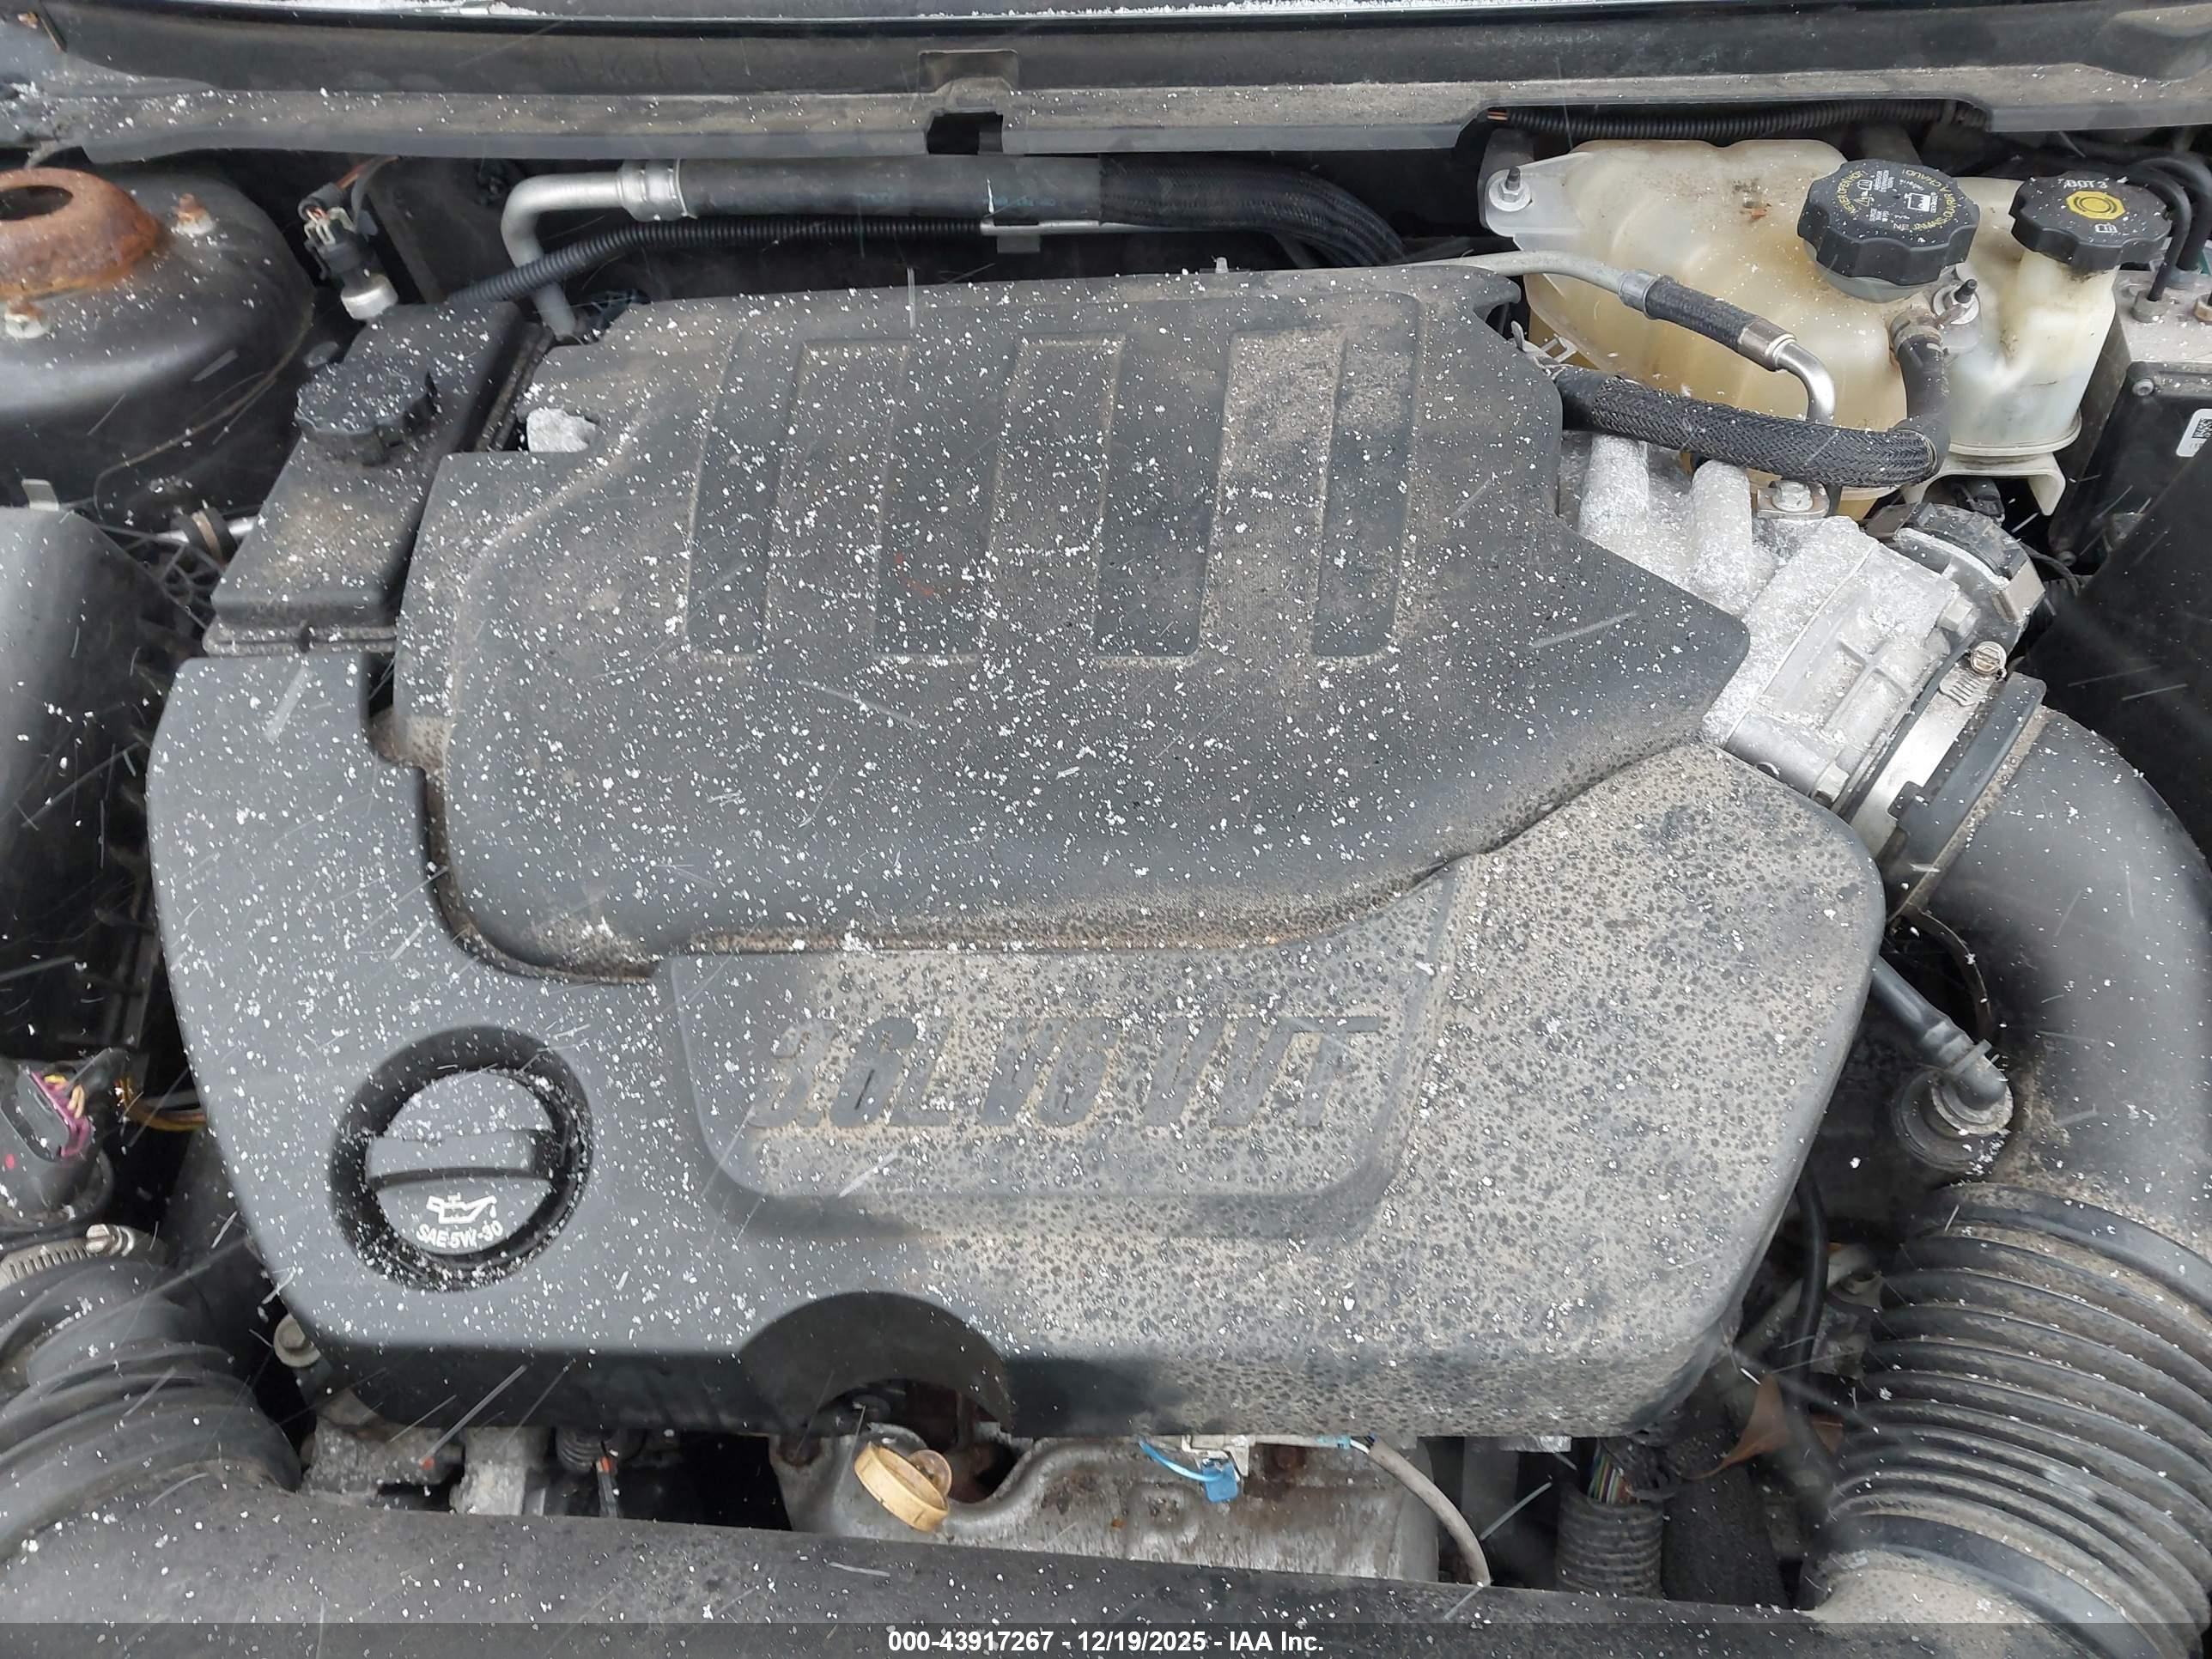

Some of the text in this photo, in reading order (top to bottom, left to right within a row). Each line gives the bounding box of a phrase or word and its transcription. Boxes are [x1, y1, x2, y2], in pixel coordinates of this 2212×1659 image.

[1837, 179, 1852, 194] OPEN
[2064, 179, 2095, 188] DOT
[1838, 194, 1857, 215] NEVER
[1144, 1016, 1381, 1127] VVT
[416, 1219, 504, 1249] SAE 5W-30
